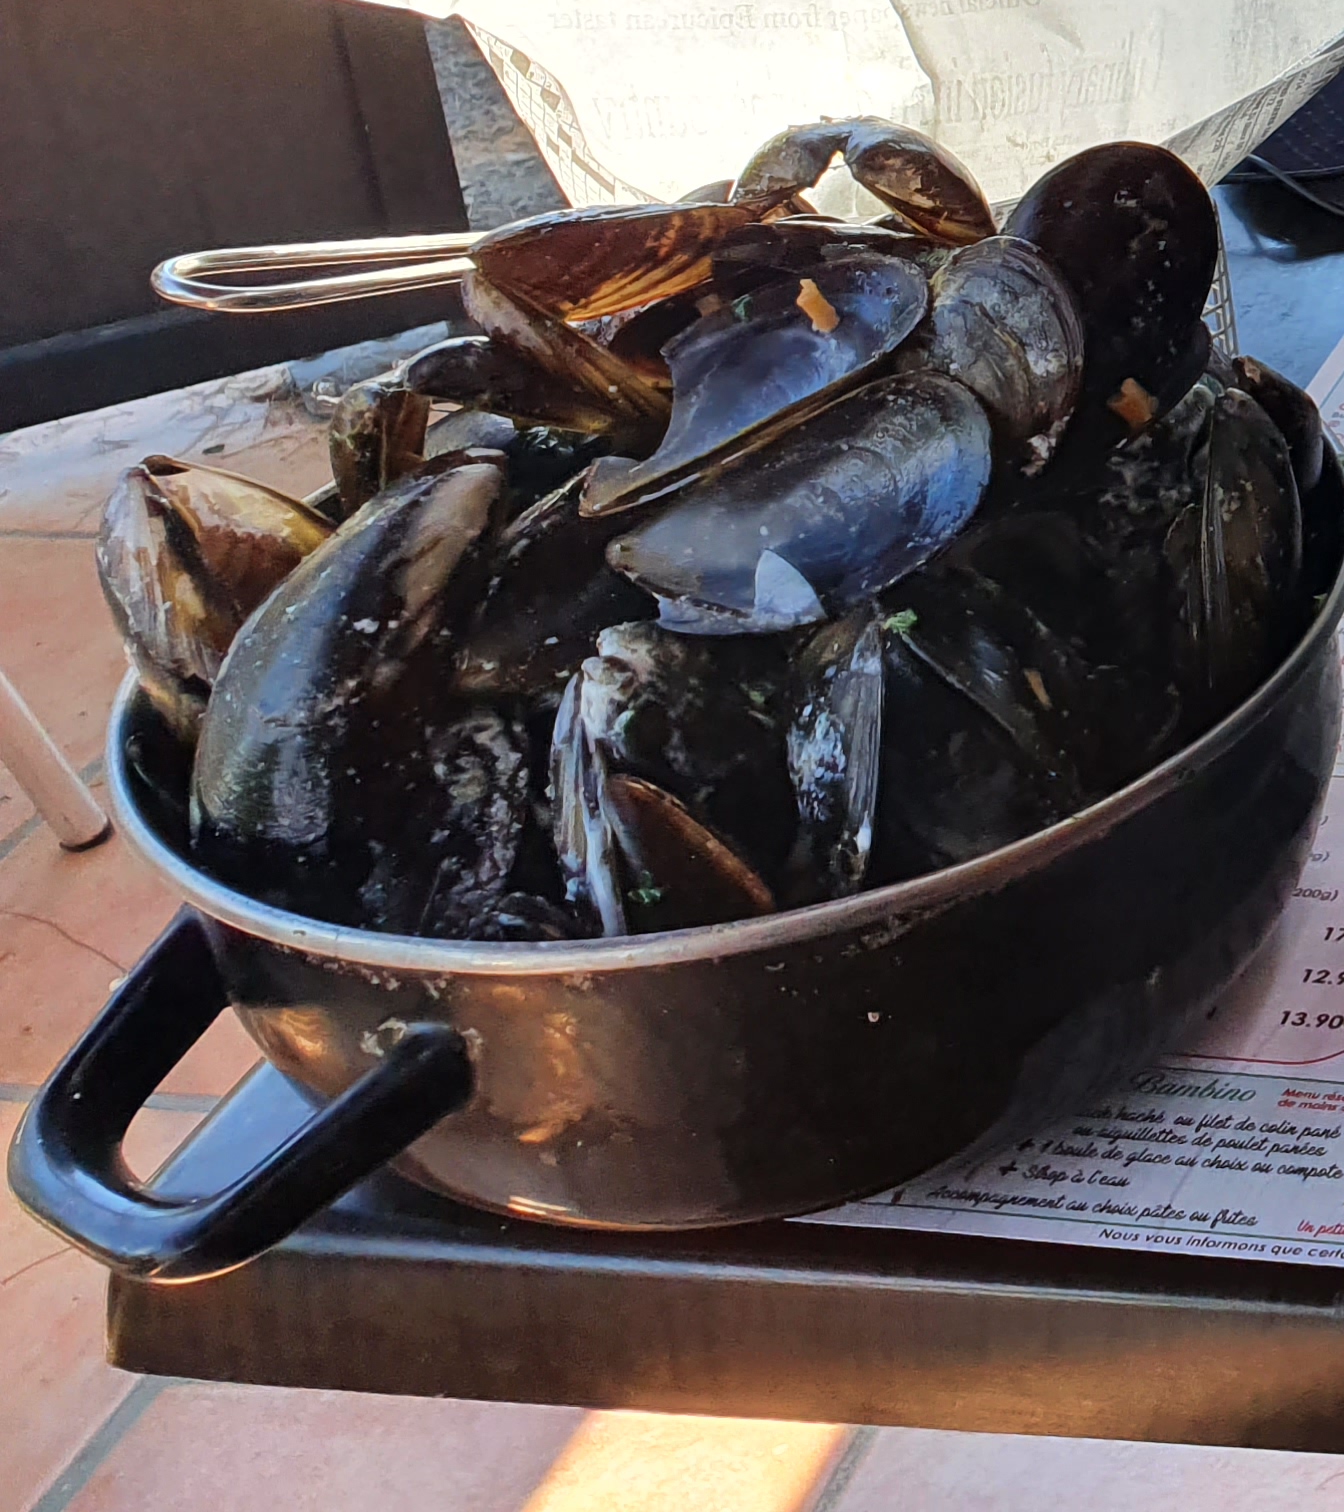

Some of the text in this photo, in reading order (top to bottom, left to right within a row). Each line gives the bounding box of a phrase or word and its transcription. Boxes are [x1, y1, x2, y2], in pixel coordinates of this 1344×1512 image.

[1129, 1072, 1257, 1103] Bambino
[1099, 1228, 1141, 1242] Nous
[1145, 1234, 1183, 1248] vous
[1185, 1235, 1266, 1254] informons
[1271, 1244, 1304, 1258] que
